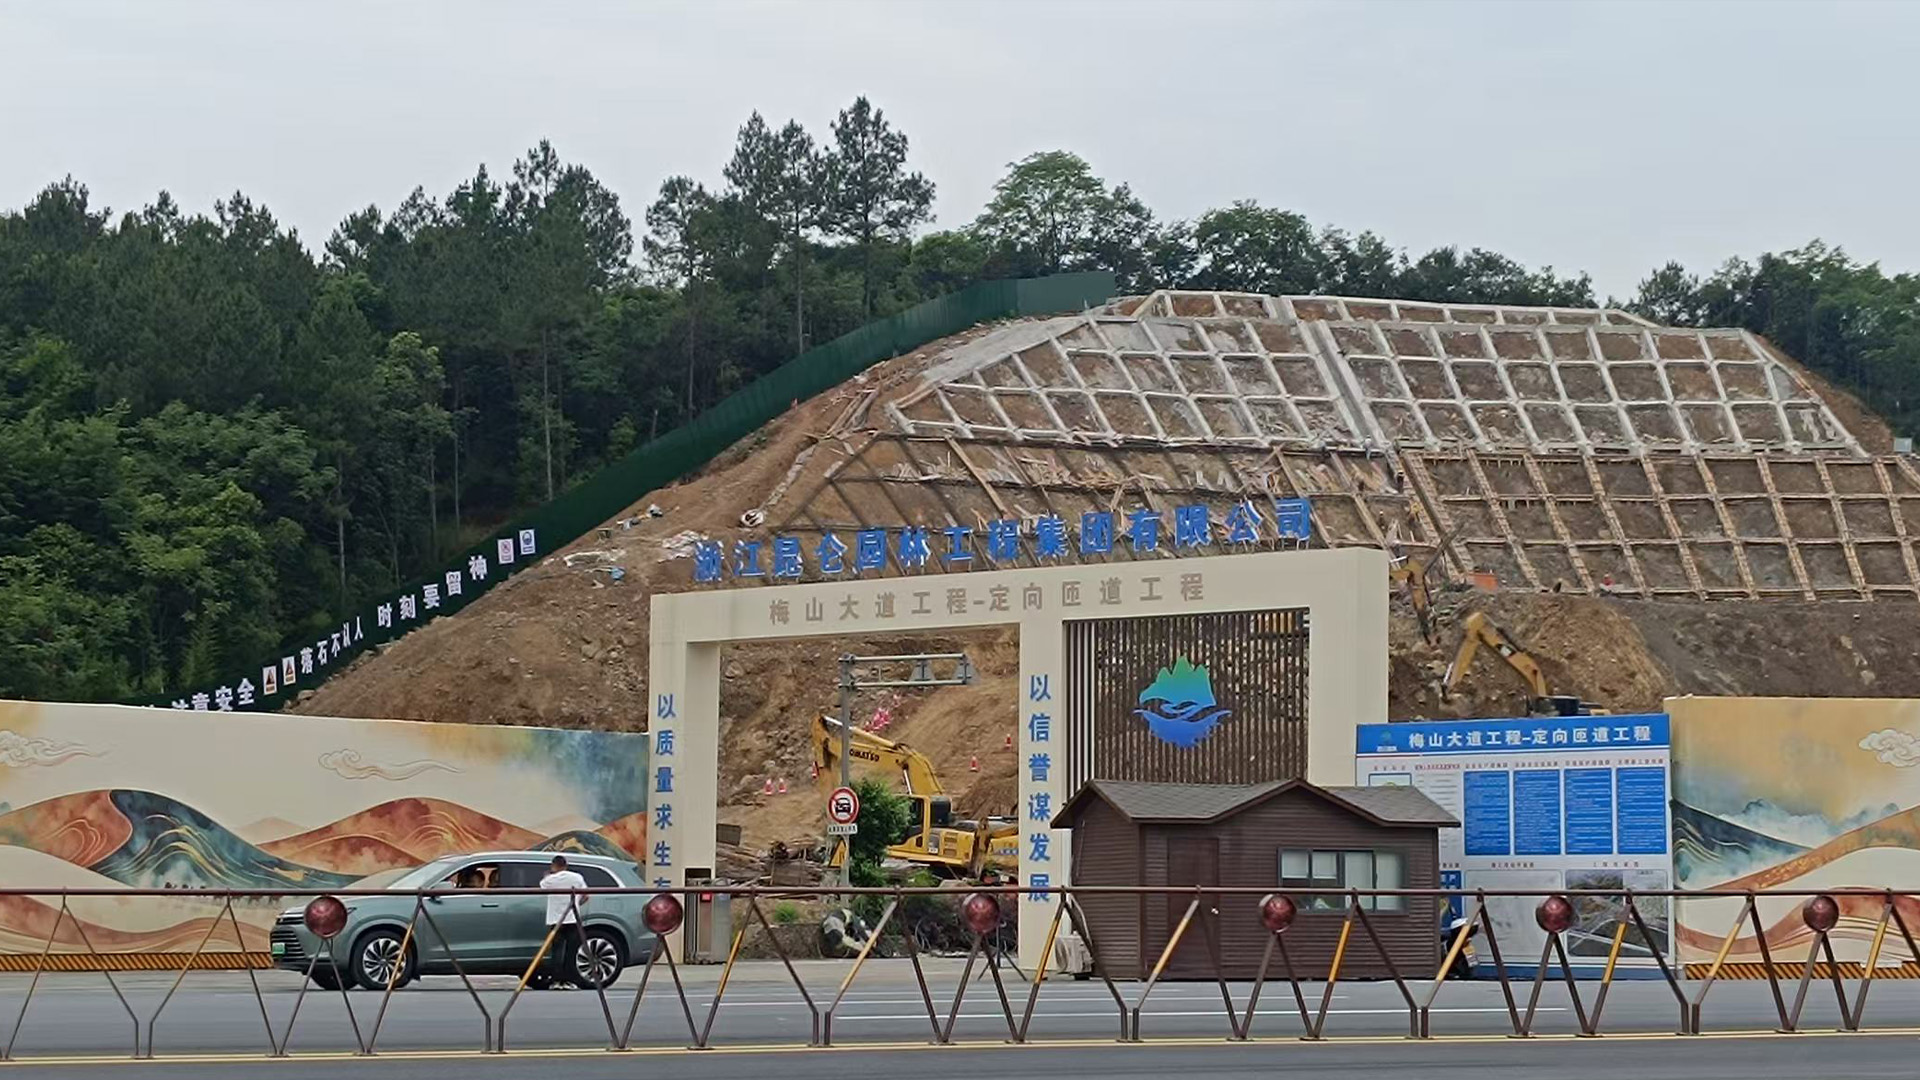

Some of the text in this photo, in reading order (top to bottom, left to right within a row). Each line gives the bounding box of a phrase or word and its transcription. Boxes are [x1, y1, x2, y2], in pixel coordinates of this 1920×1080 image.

[695, 497, 1311, 582] 浙江昆仑园林工程集团有限公司
[376, 555, 488, 628] 时刻要留神
[769, 573, 1204, 624] 梅山大道工程-定向匝道工程
[1408, 725, 1651, 749] 梅山大道工程-定向匝道工程
